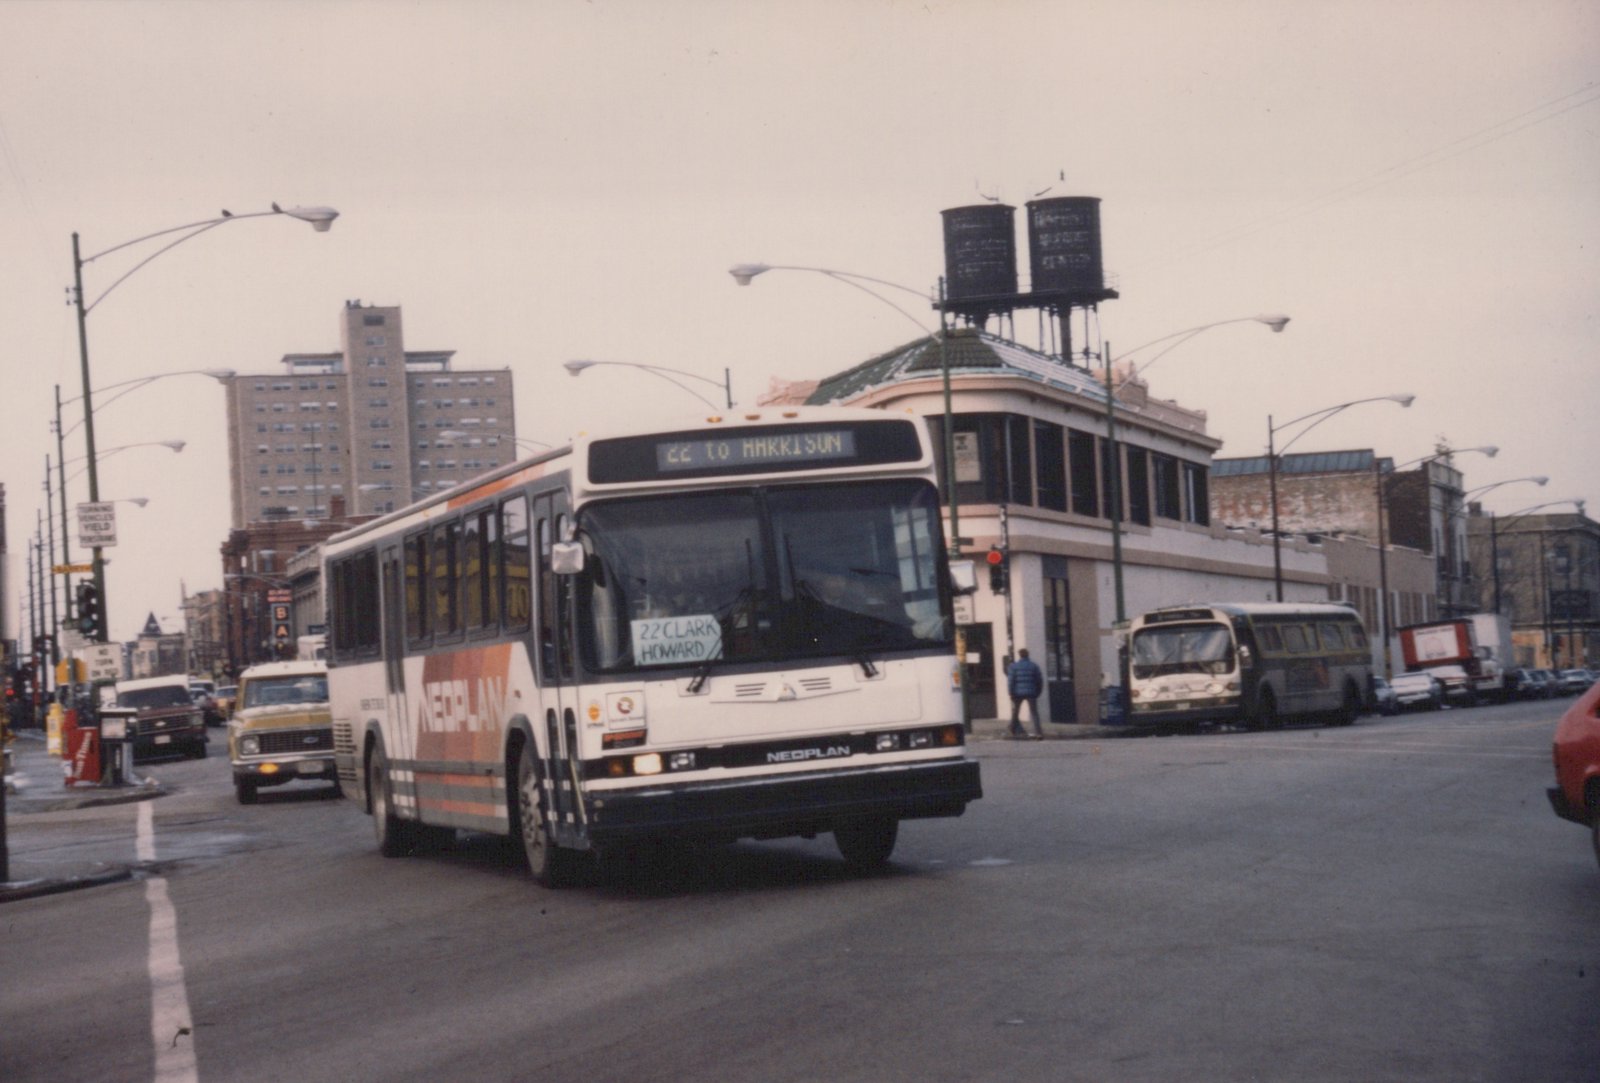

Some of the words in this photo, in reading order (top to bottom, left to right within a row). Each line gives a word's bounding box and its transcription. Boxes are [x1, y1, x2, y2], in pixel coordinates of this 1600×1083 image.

[83, 522, 111, 532] YIELD
[641, 623, 660, 640] 22
[663, 619, 718, 639] CLARK
[641, 640, 704, 661] HOWARD
[421, 675, 505, 733] NEOPLAN
[766, 746, 851, 762] NEOPLAN
